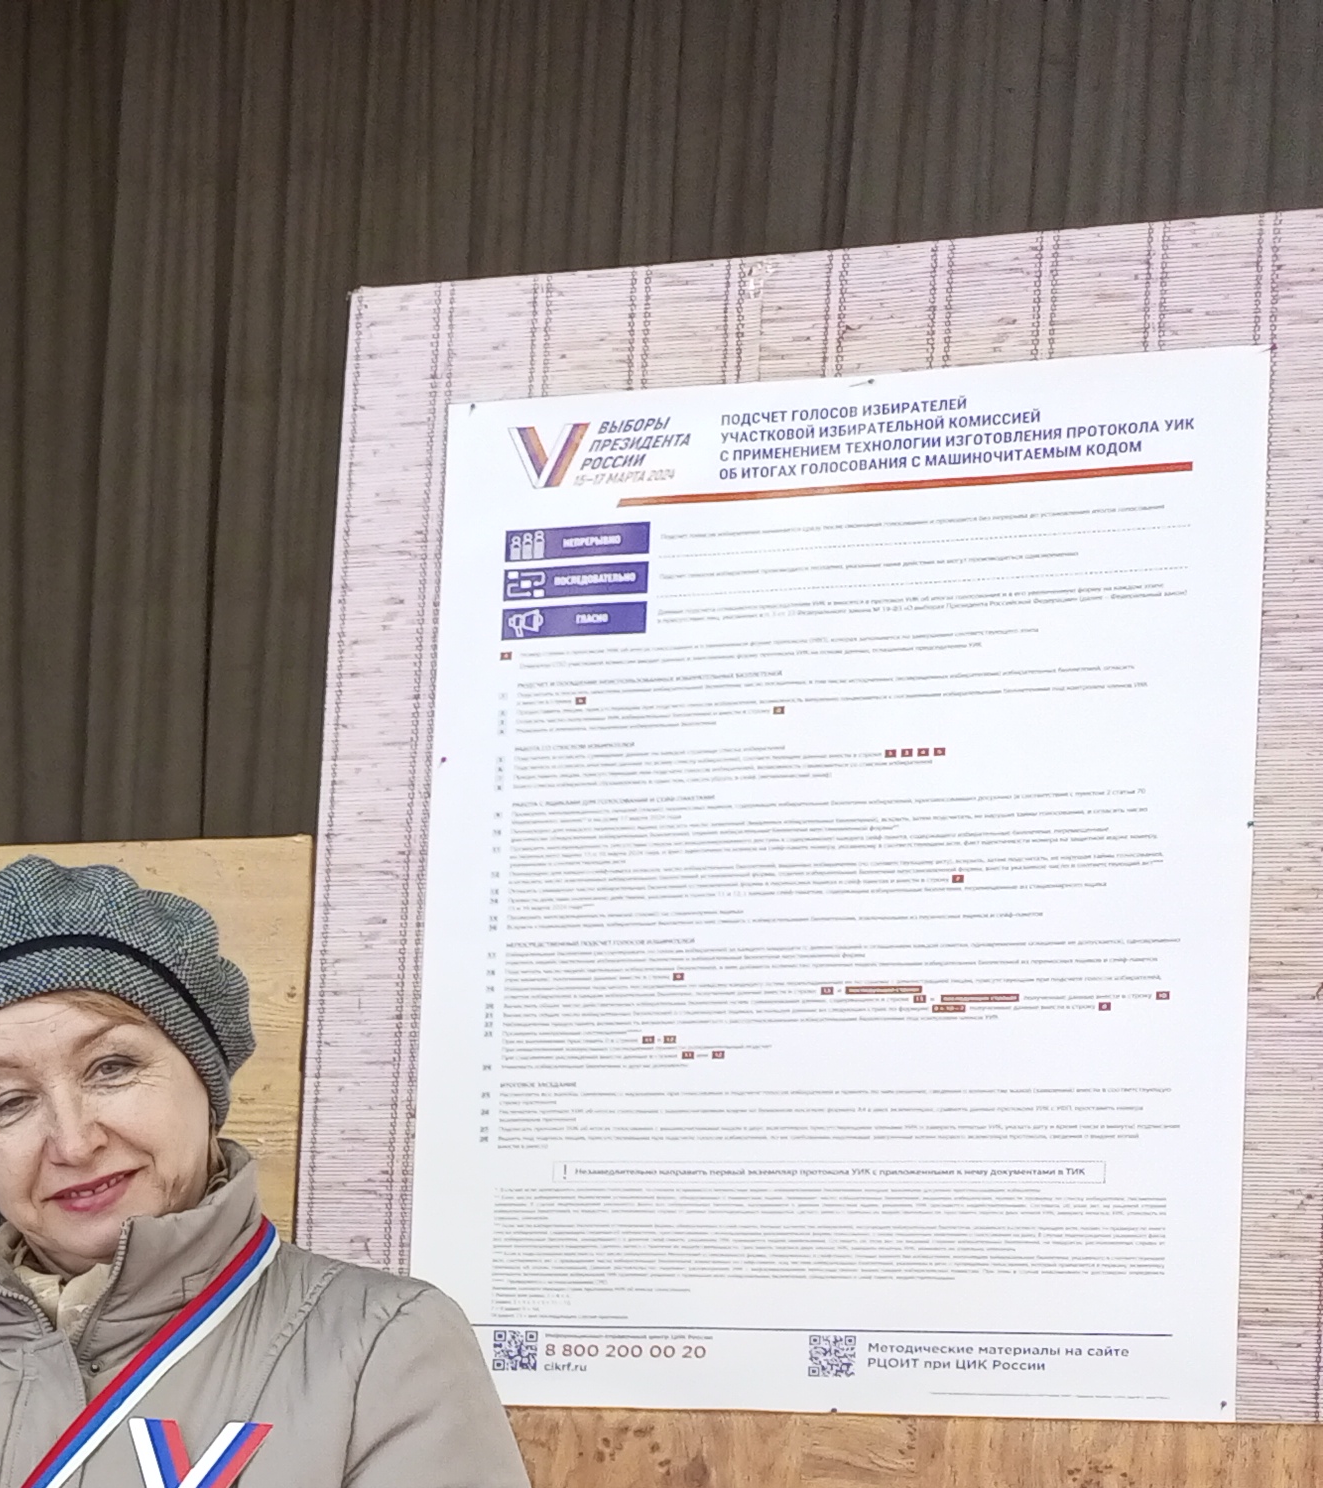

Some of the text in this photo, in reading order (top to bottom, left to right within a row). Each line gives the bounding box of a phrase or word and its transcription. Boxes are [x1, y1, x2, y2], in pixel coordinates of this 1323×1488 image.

[721, 395, 967, 426] ПОДСЧЕТ ГОЛОСОВ ИЗБИРАТЕЛЕЙ
[597, 416, 671, 434] ВЫБОРЫ
[720, 408, 1041, 443] УЧАСТКОВОЙ ИЗБИРАТЕЛЬНОЙ КОМИССИЕЙ
[588, 433, 691, 452] ПРЕЗИДЕНТА
[719, 417, 1194, 462] С ПРИМЕНЕНИЕМ ТЕХНОЛОГИИ ИЗГОТОВЛЕНИЯ ПРОТОКОЛА УИК
[579, 453, 647, 470] РОССИИ
[719, 440, 1142, 480] ОБ ИТОГАХ ГОЛОСОВАНИЯ С МАШИНОЧИТАЕМЫМ КОДОМ
[605, 470, 646, 484] МАРТА
[1065, 1167, 1085, 1176] ТИК
[545, 1344, 706, 1358] 8 800 200 00 20
[867, 1342, 1129, 1357] Методические материалы на сайте
[544, 1361, 587, 1373] cikrf.ru
[867, 1357, 1045, 1371] РЦОИТ при ЦИК России
